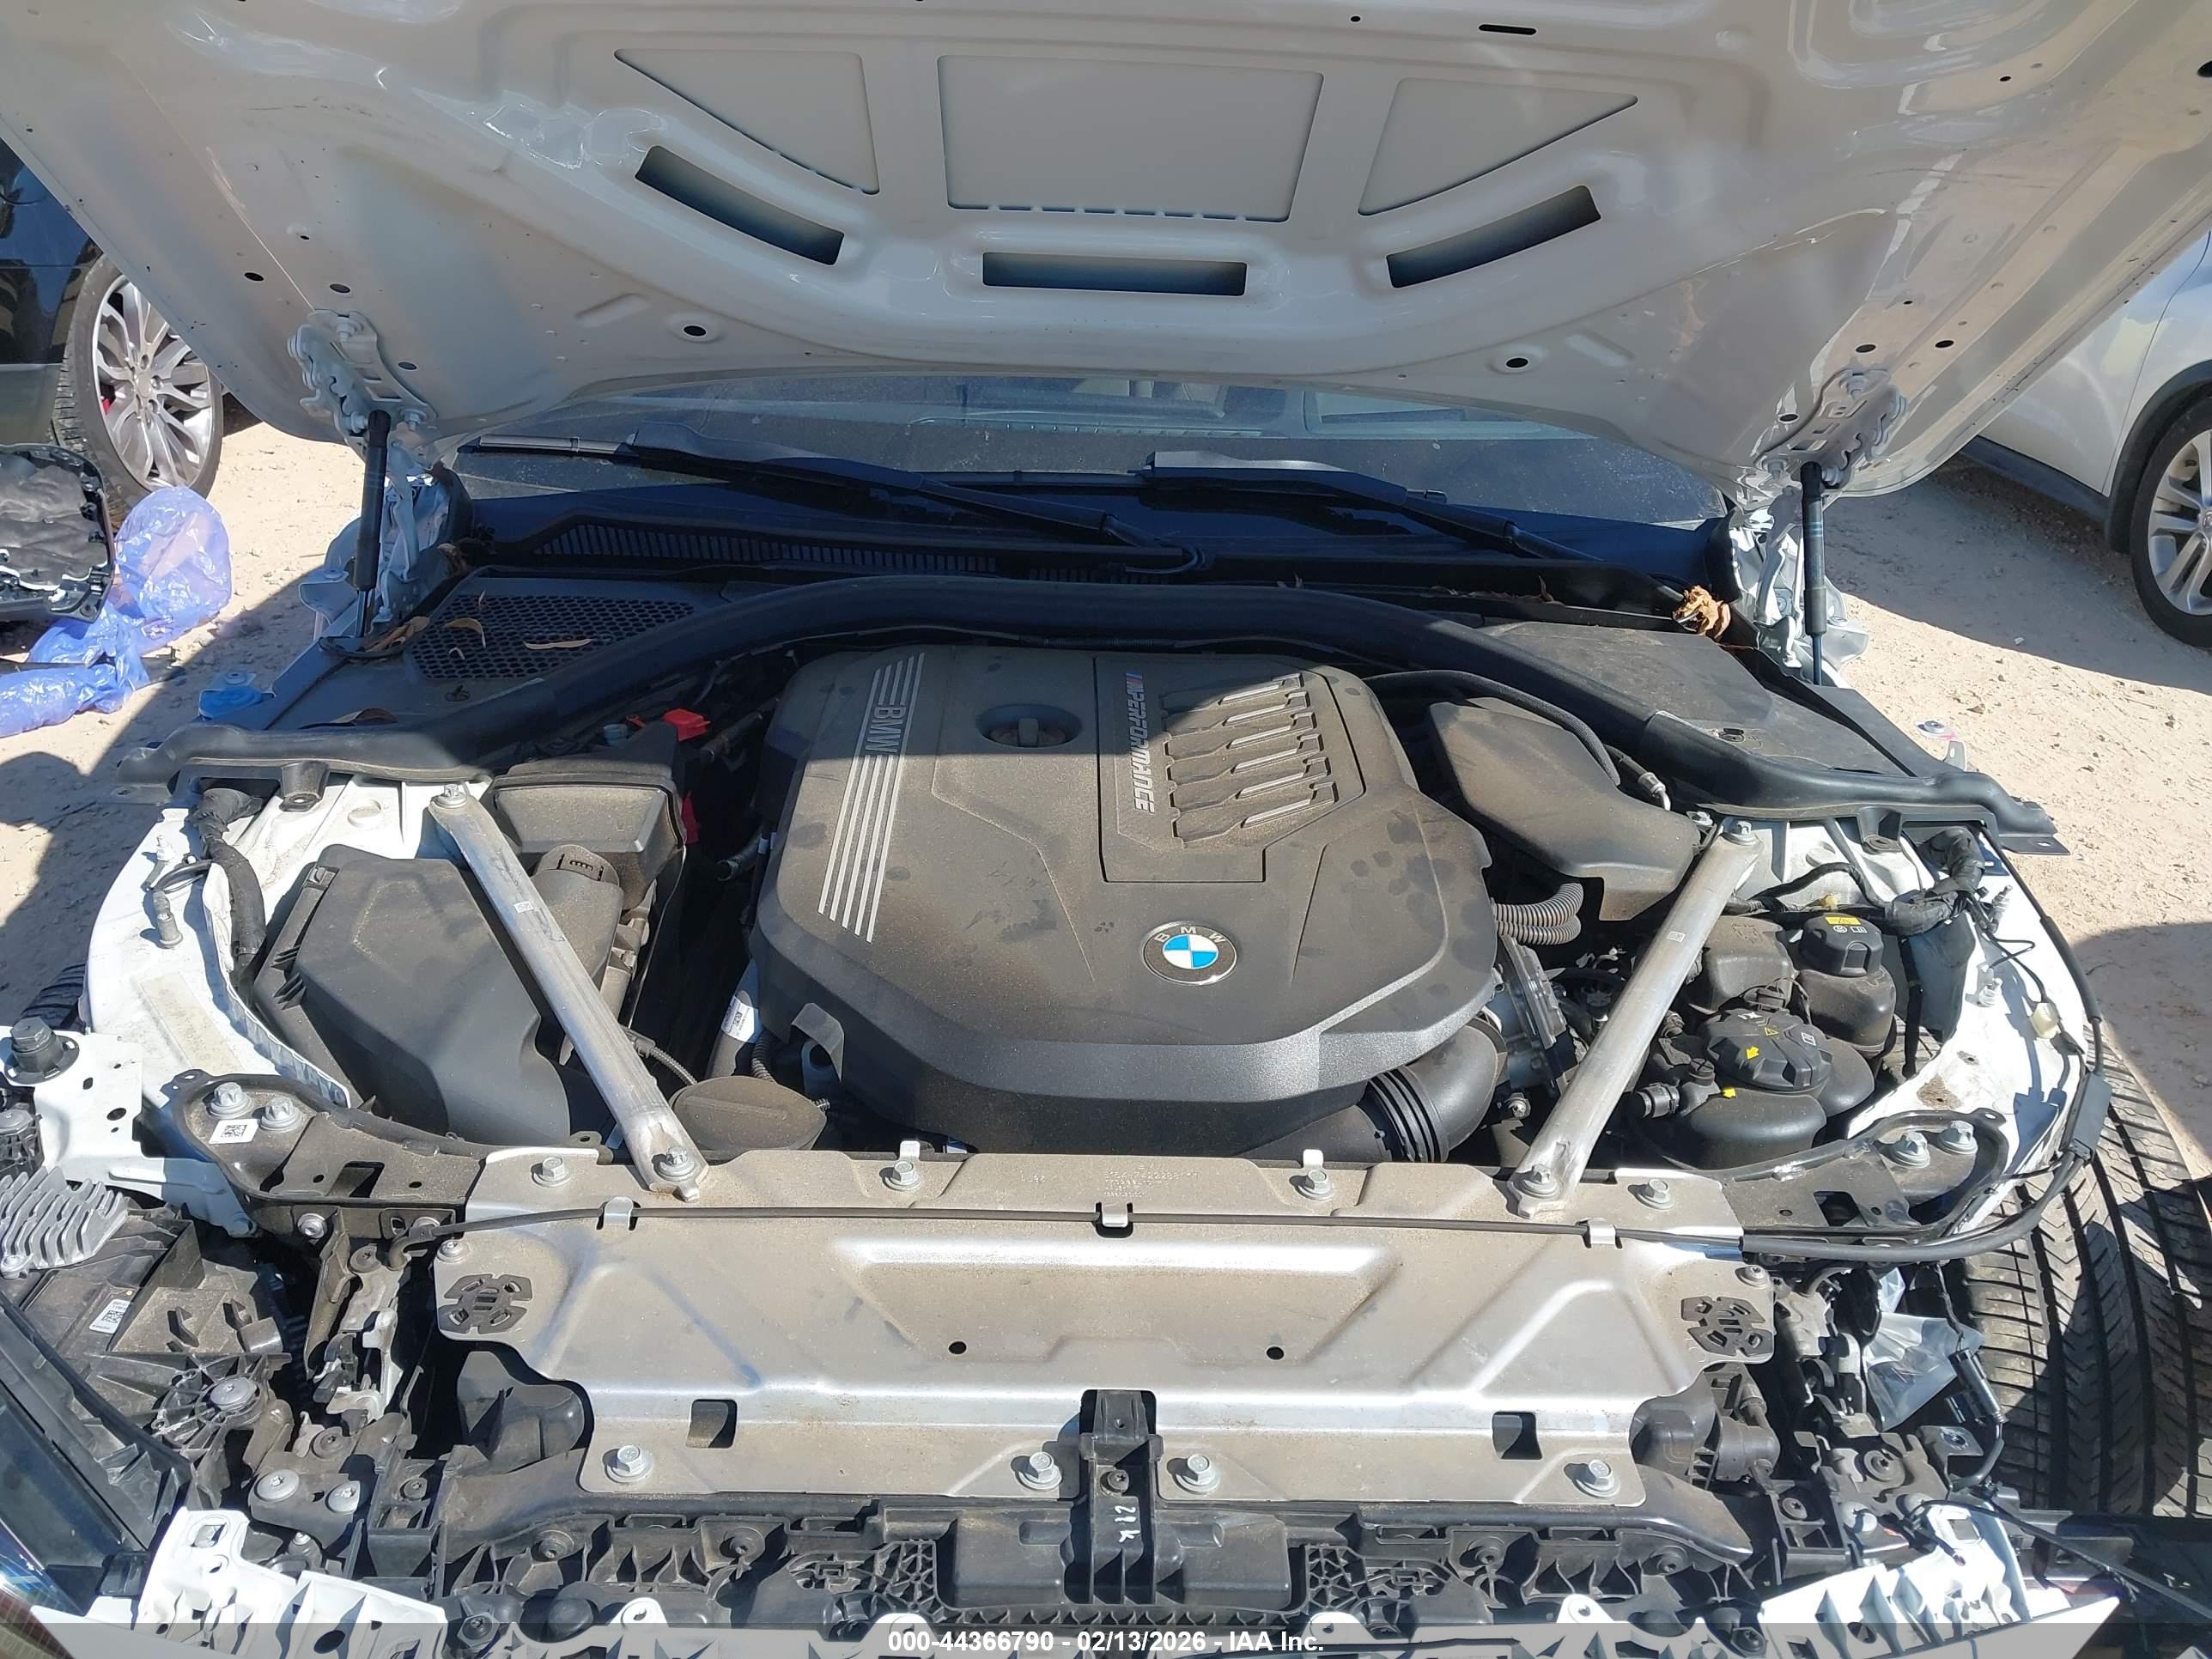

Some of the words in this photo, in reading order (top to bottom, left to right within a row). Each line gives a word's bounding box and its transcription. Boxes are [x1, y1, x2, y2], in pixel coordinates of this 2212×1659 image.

[865, 707, 907, 753] BMW
[1127, 692, 1155, 814] PERFORMANCE
[1153, 927, 1226, 944] BMW
